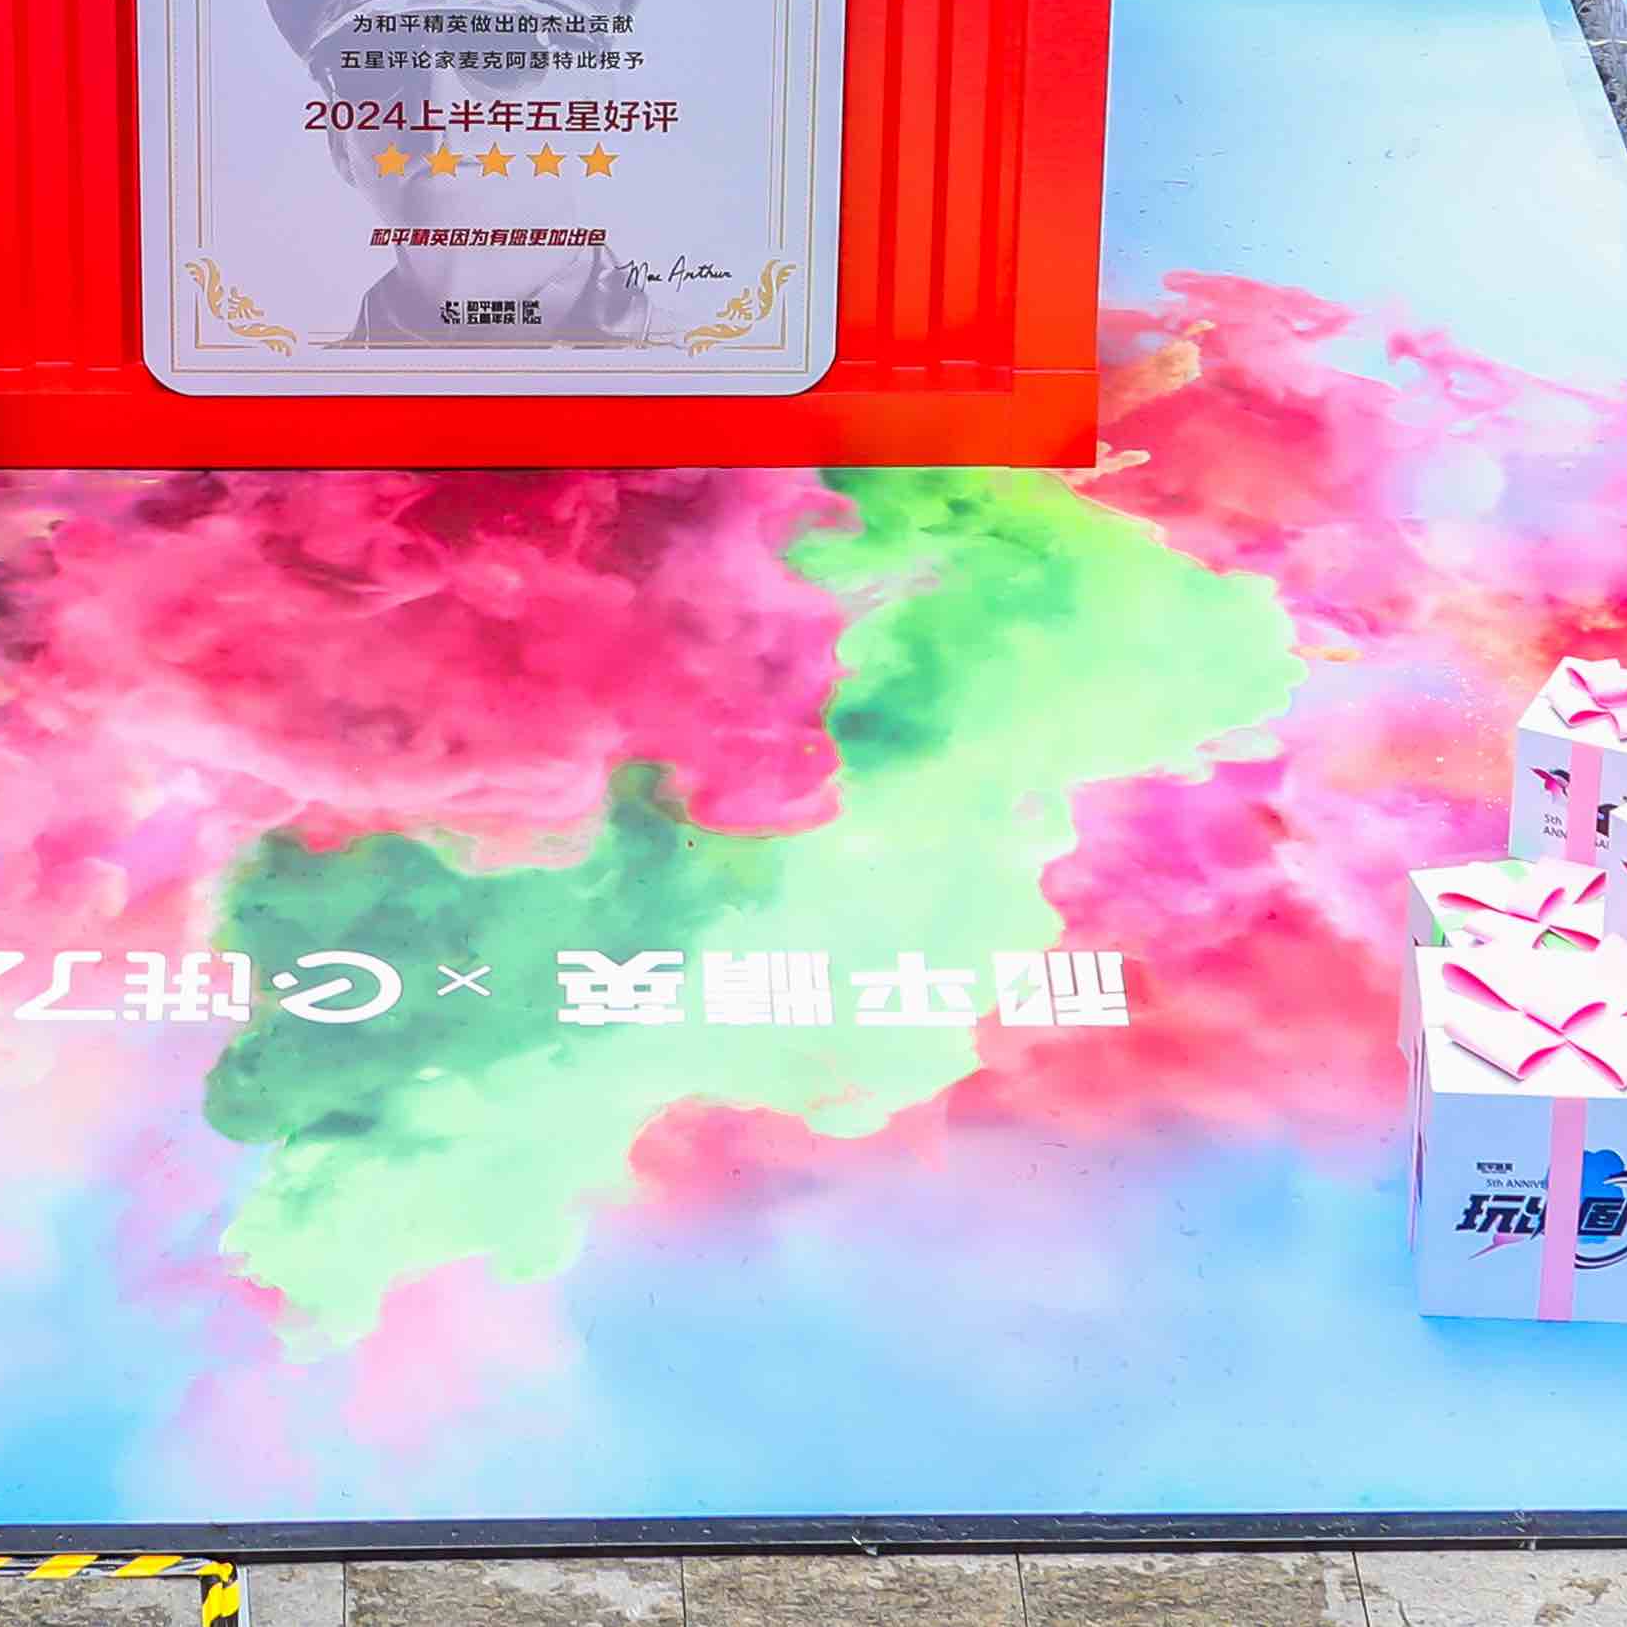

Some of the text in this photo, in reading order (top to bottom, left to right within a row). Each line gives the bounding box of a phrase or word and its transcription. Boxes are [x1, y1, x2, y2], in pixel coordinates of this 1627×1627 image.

[352, 14, 636, 35] 为和平精英做出的杰出贡献
[340, 50, 646, 72] 五星评论家麦克阿瑟特此授予
[303, 99, 680, 133] 2024上半年五星好评
[370, 227, 607, 247] 和平精英因为有您更加出色
[556, 948, 1131, 1026] 和平精英
